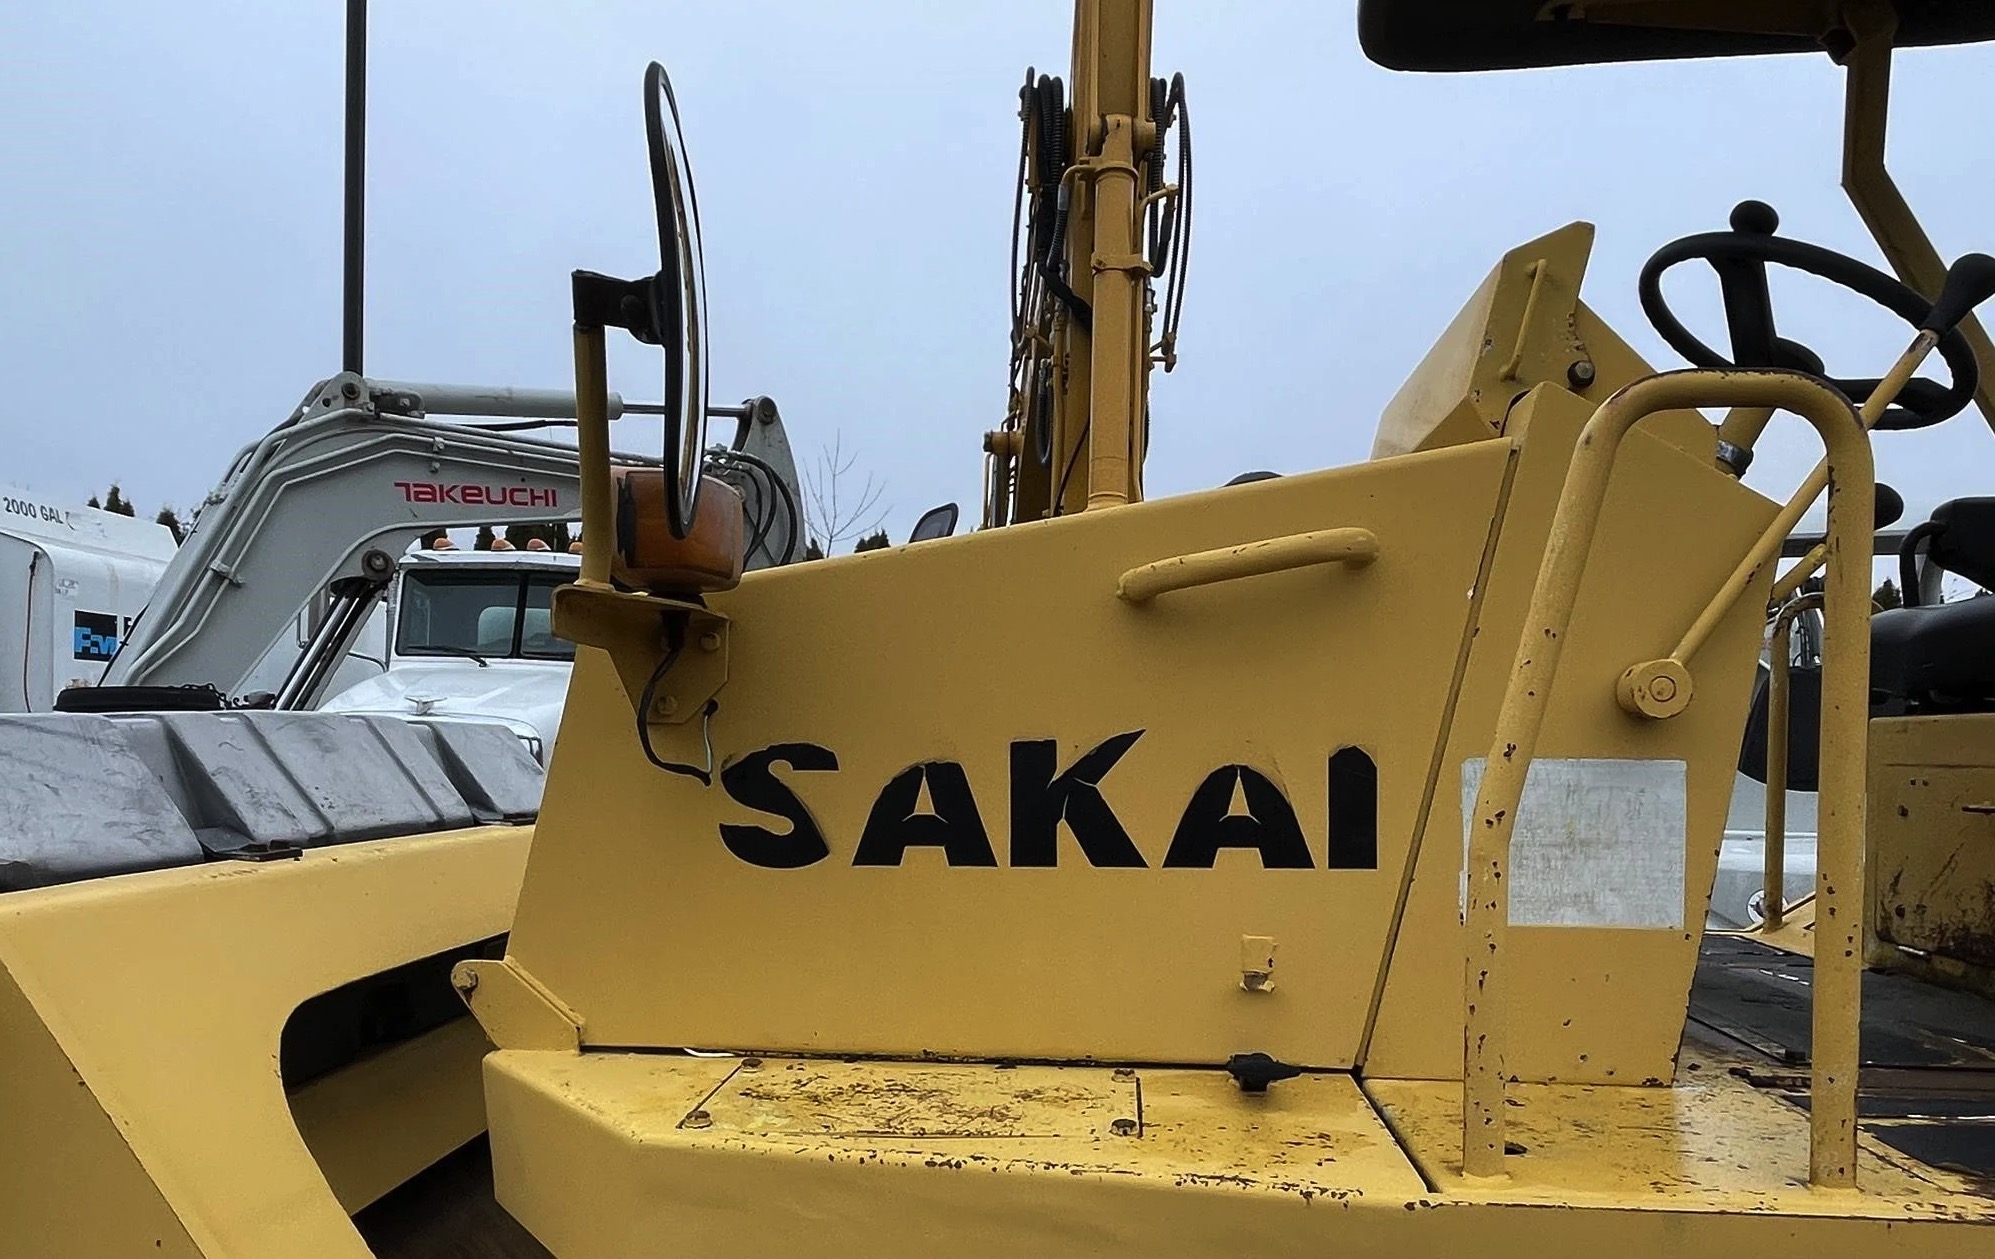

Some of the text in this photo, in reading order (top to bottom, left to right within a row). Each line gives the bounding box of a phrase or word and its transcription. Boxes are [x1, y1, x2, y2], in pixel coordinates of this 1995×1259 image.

[3, 496, 37, 519] 2000
[40, 504, 64, 524] GAL
[719, 728, 1378, 870] SAKAI
